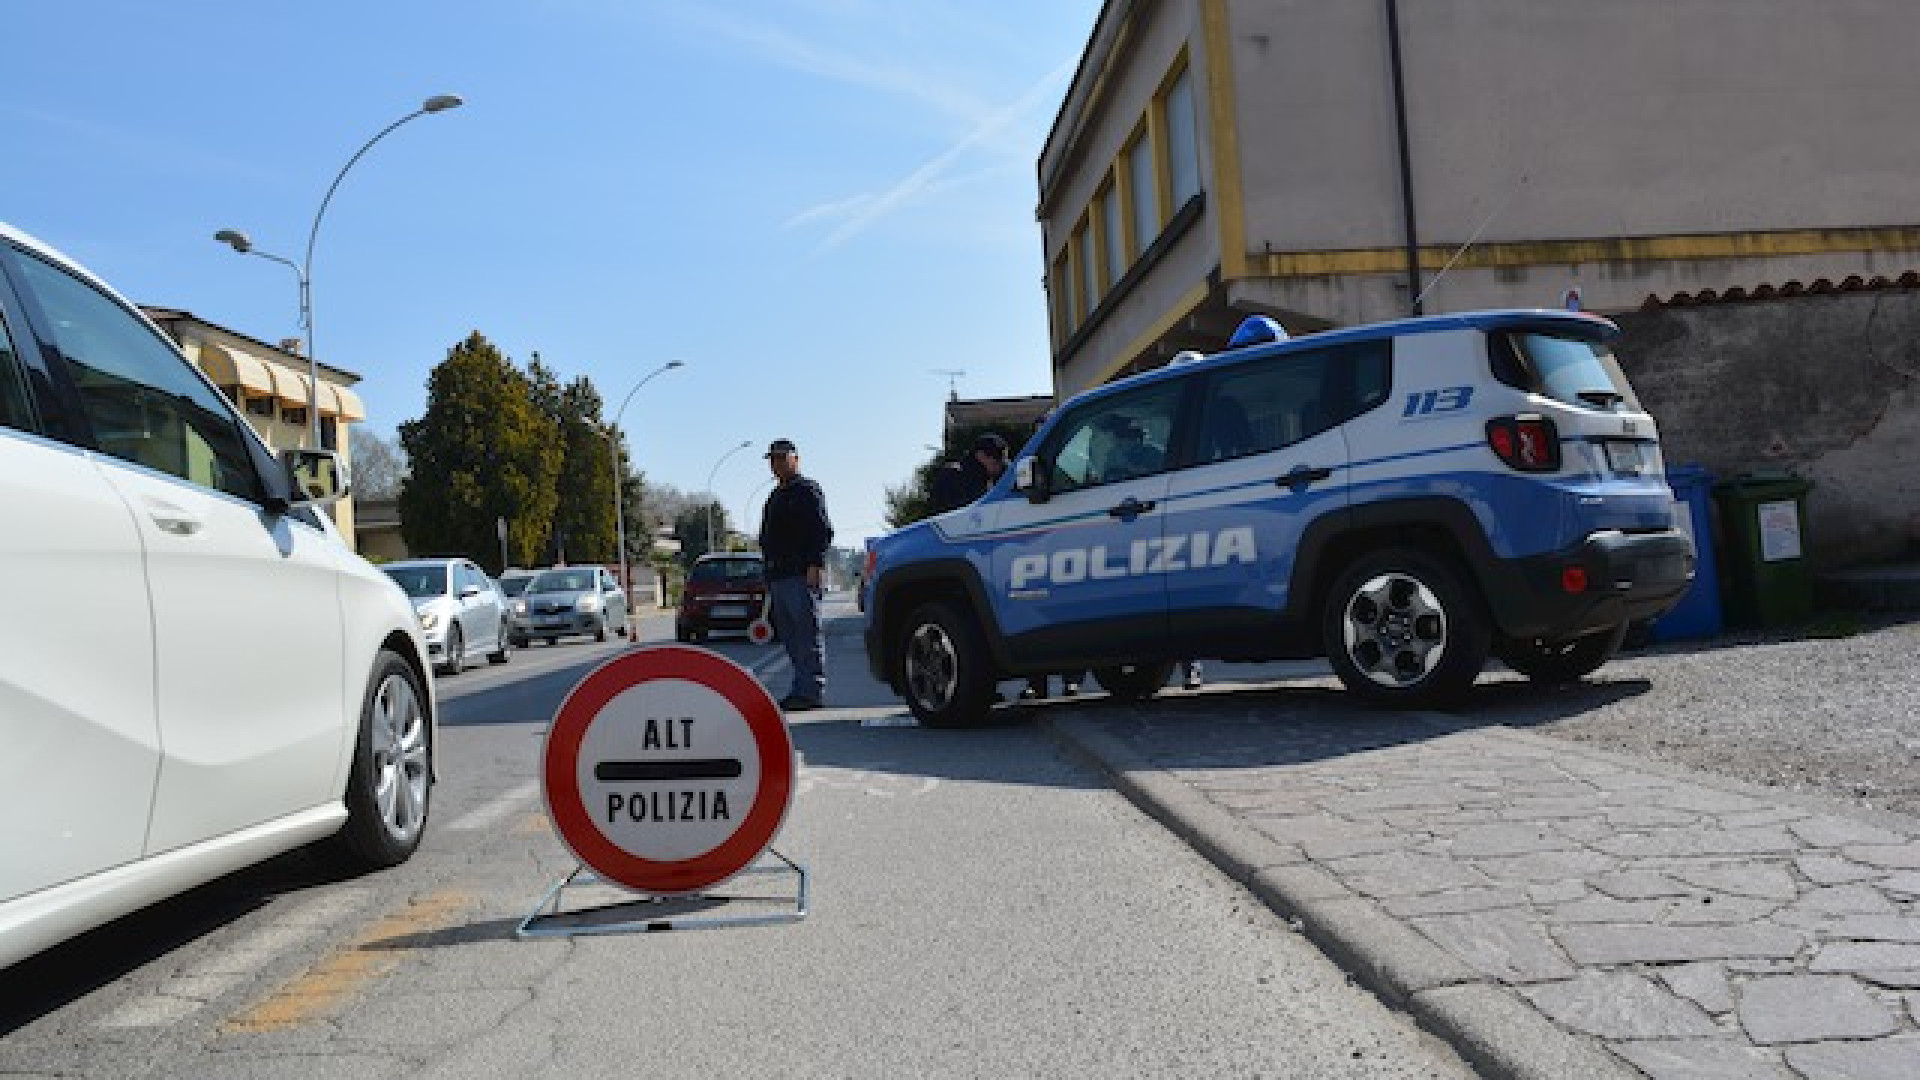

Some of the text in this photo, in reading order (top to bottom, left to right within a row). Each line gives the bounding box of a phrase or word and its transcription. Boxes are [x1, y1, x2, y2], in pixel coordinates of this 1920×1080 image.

[1403, 387, 1473, 416] 113
[1010, 527, 1257, 589] POLIZIA
[643, 718, 694, 750] ALT
[607, 790, 730, 823] POLIZIA
